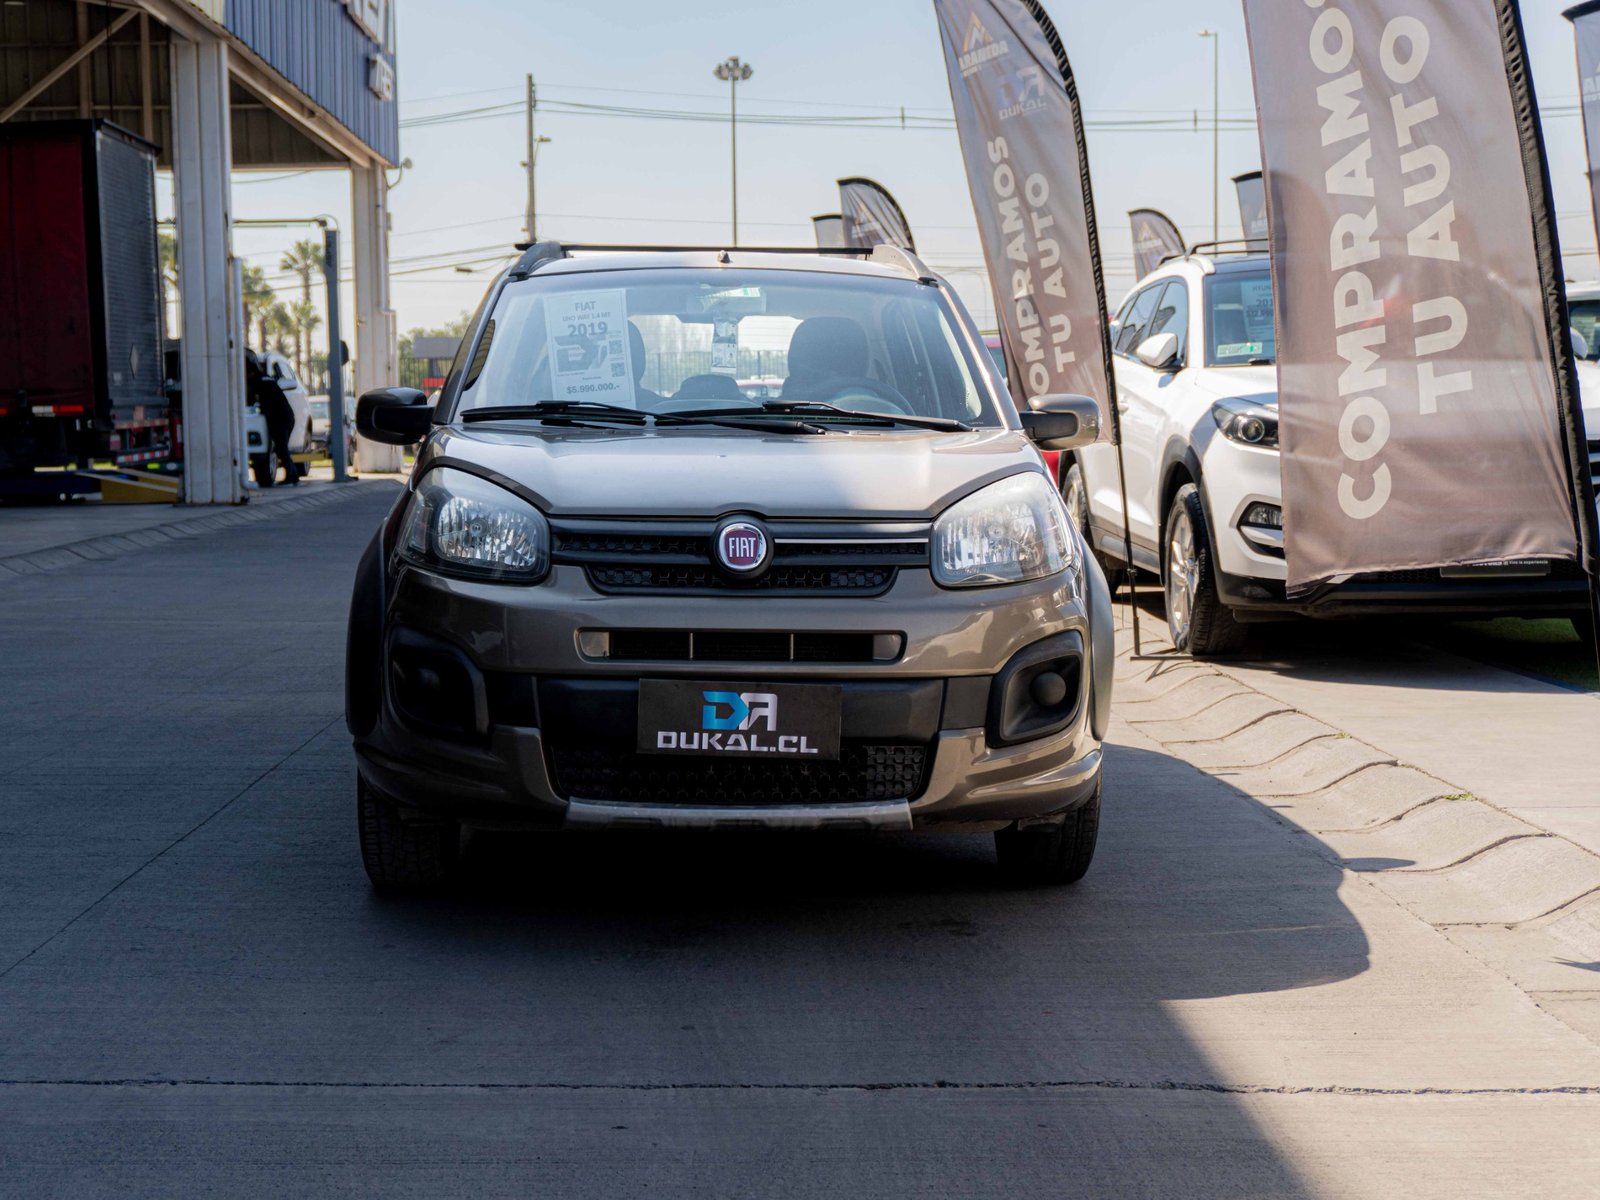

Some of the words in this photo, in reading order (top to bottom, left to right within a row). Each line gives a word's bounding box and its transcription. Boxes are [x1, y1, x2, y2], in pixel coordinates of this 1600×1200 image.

[1379, 15, 1460, 262] AUTO
[987, 136, 1050, 396] OMPRAMOS
[1025, 172, 1067, 298] AUTO
[1304, 0, 1392, 520] COMPRAMO
[568, 321, 607, 337] 2019
[575, 301, 596, 311] FIAT
[1049, 313, 1076, 373] TU
[1412, 296, 1473, 415] TU
[728, 537, 757, 558] FIAT
[657, 731, 819, 754] DUKAL.CL
